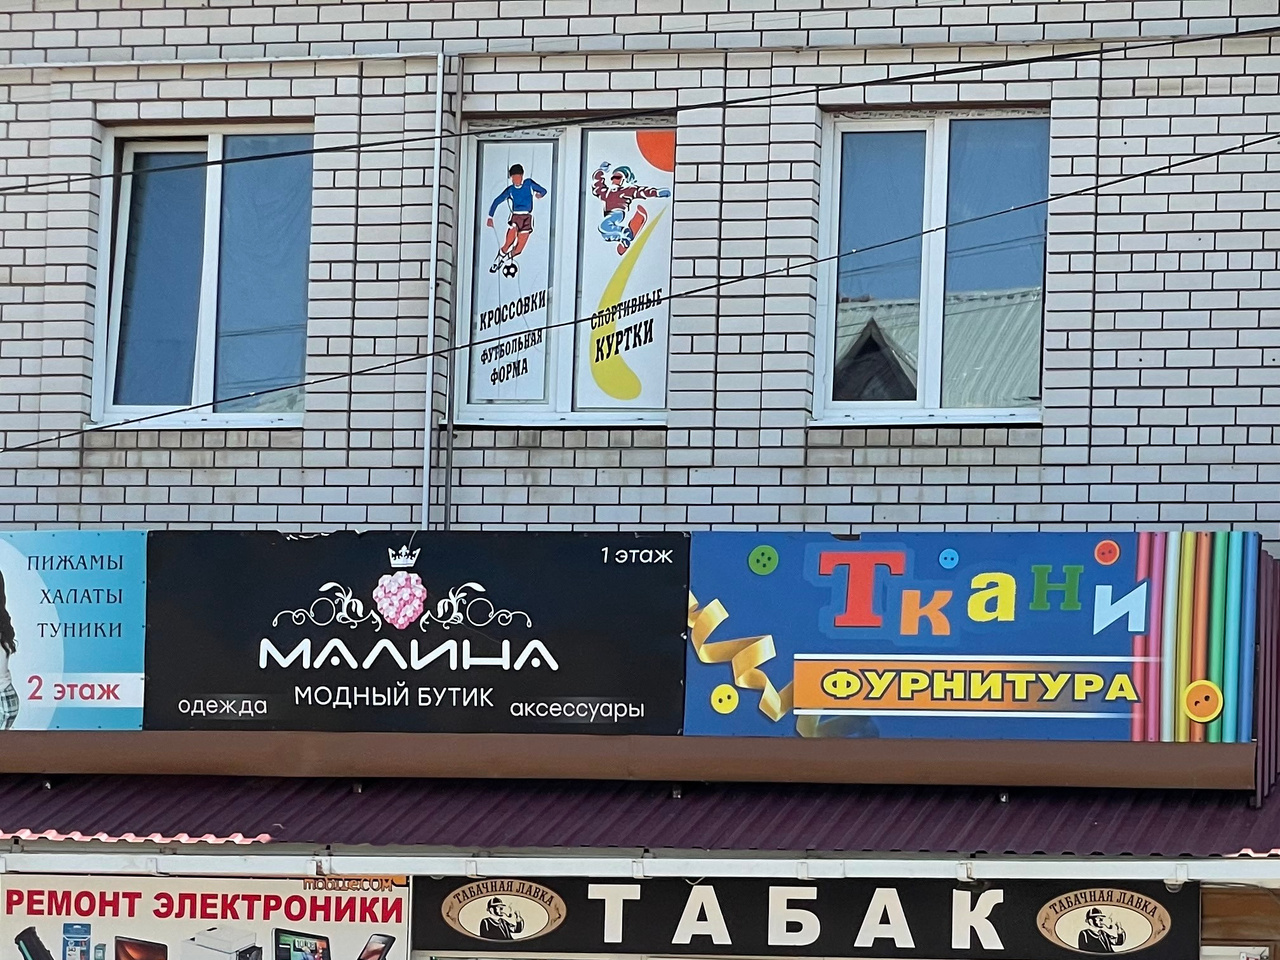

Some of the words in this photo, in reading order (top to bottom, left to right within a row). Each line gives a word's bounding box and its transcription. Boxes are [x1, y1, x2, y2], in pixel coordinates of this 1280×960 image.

[479, 289, 546, 331] КРОССОВКИ
[590, 288, 662, 330] СПОРТИВНЫЕ
[480, 329, 543, 365] ФУТБОЛЬНАЯ
[594, 318, 654, 363] КУРТКИ
[490, 357, 528, 385] ФОРМА
[27, 555, 124, 570] ПИЖАМЫ
[600, 546, 609, 563] 1
[615, 548, 673, 564] этаж
[40, 589, 123, 604] ХАЛАТЫ
[820, 551, 1149, 635] Ткани
[37, 623, 122, 638] ТУНИКИ
[258, 638, 559, 671] МАЛИНА
[28, 675, 43, 700] 2
[53, 683, 120, 701] этаж
[294, 683, 409, 709] МОДНЫЙ
[418, 686, 493, 707] БУТИК
[821, 670, 1140, 702] ФУРНИТУРА
[178, 695, 268, 718] одежда
[509, 700, 645, 722] аксессуары
[5, 889, 142, 917] РЕМОНТ
[153, 893, 402, 923] ЭЛЕКТРОНИКИ
[453, 881, 514, 904] ТАБАЧНАЯ
[515, 882, 554, 907] ЛАВКА
[1049, 890, 1114, 915] ТАБАЧНАЯ
[1116, 891, 1158, 918] ЛАВКА
[588, 884, 1005, 950] ТАБАК
